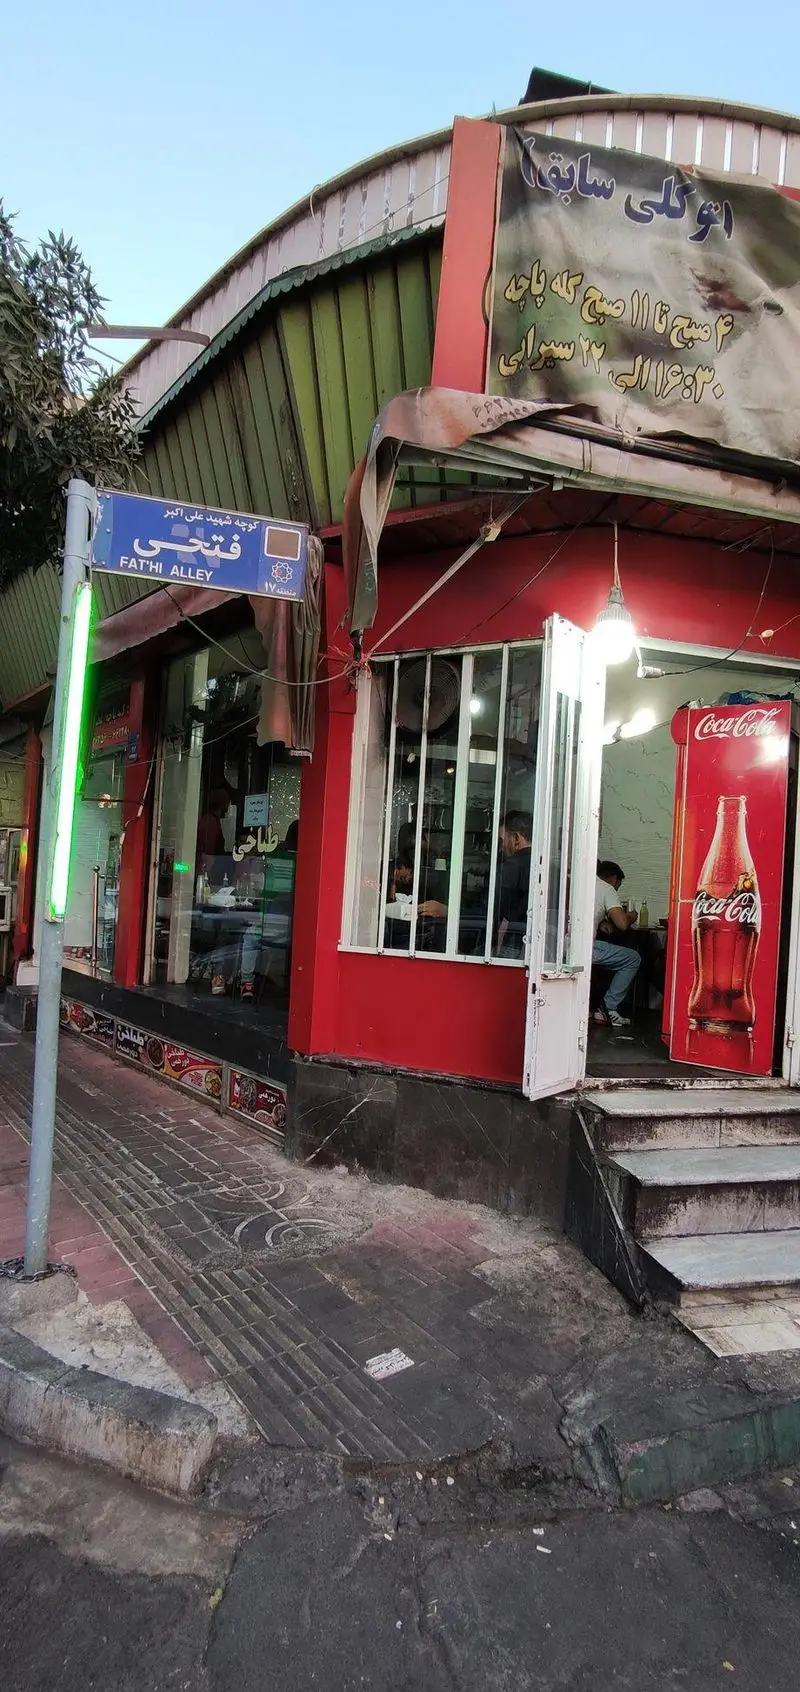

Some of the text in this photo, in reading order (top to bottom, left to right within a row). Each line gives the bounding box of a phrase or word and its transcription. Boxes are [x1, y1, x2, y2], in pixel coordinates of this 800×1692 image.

[503, 258, 735, 352] ۴ صبح تا ۱۱ صبح کله پاچه
[497, 323, 576, 378] سیرابی
[608, 353, 652, 394] الی
[163, 507, 260, 532] کوچه شهید علی اکبر
[133, 532, 242, 560] فتحی
[119, 556, 213, 582] FAT'HI ALLEY
[263, 580, 278, 593] ۱۷
[232, 825, 279, 861] طباخی
